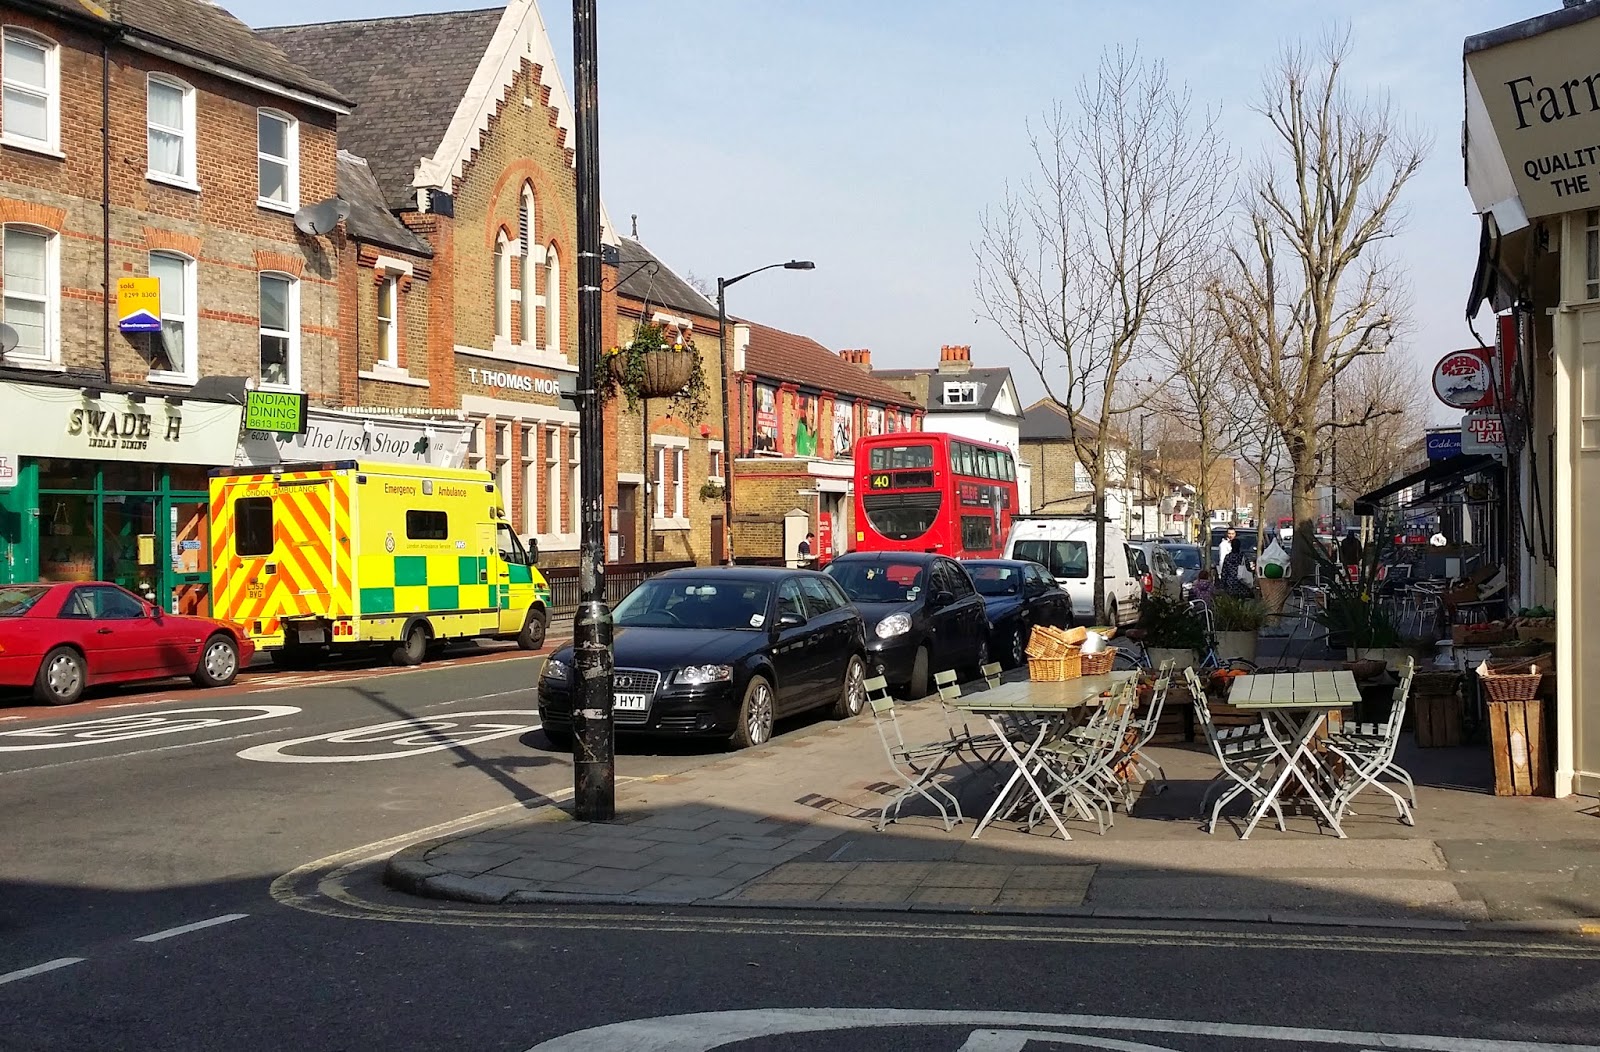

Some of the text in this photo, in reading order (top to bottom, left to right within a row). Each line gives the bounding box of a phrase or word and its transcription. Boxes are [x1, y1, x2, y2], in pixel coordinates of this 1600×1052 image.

[1524, 145, 1600, 182] QUALIT
[1551, 175, 1590, 197] THE
[481, 370, 532, 391] THOMAS
[252, 394, 297, 406] INDIAN
[250, 406, 297, 419] DINING
[249, 419, 296, 430] 8613 1501
[1469, 420, 1502, 432] JUST
[251, 432, 270, 441] 6020
[303, 426, 410, 457] The Irish Shop
[1477, 431, 1502, 443] EAT
[88, 438, 147, 450] INDIAN DINING
[434, 443, 444, 451] 118
[873, 475, 889, 487] 40
[242, 485, 318, 497] LONDON AMBULANCE
[384, 482, 467, 498] Emergency Ambulance
[620, 695, 643, 707] HYT
[6, 717, 221, 738] 20
